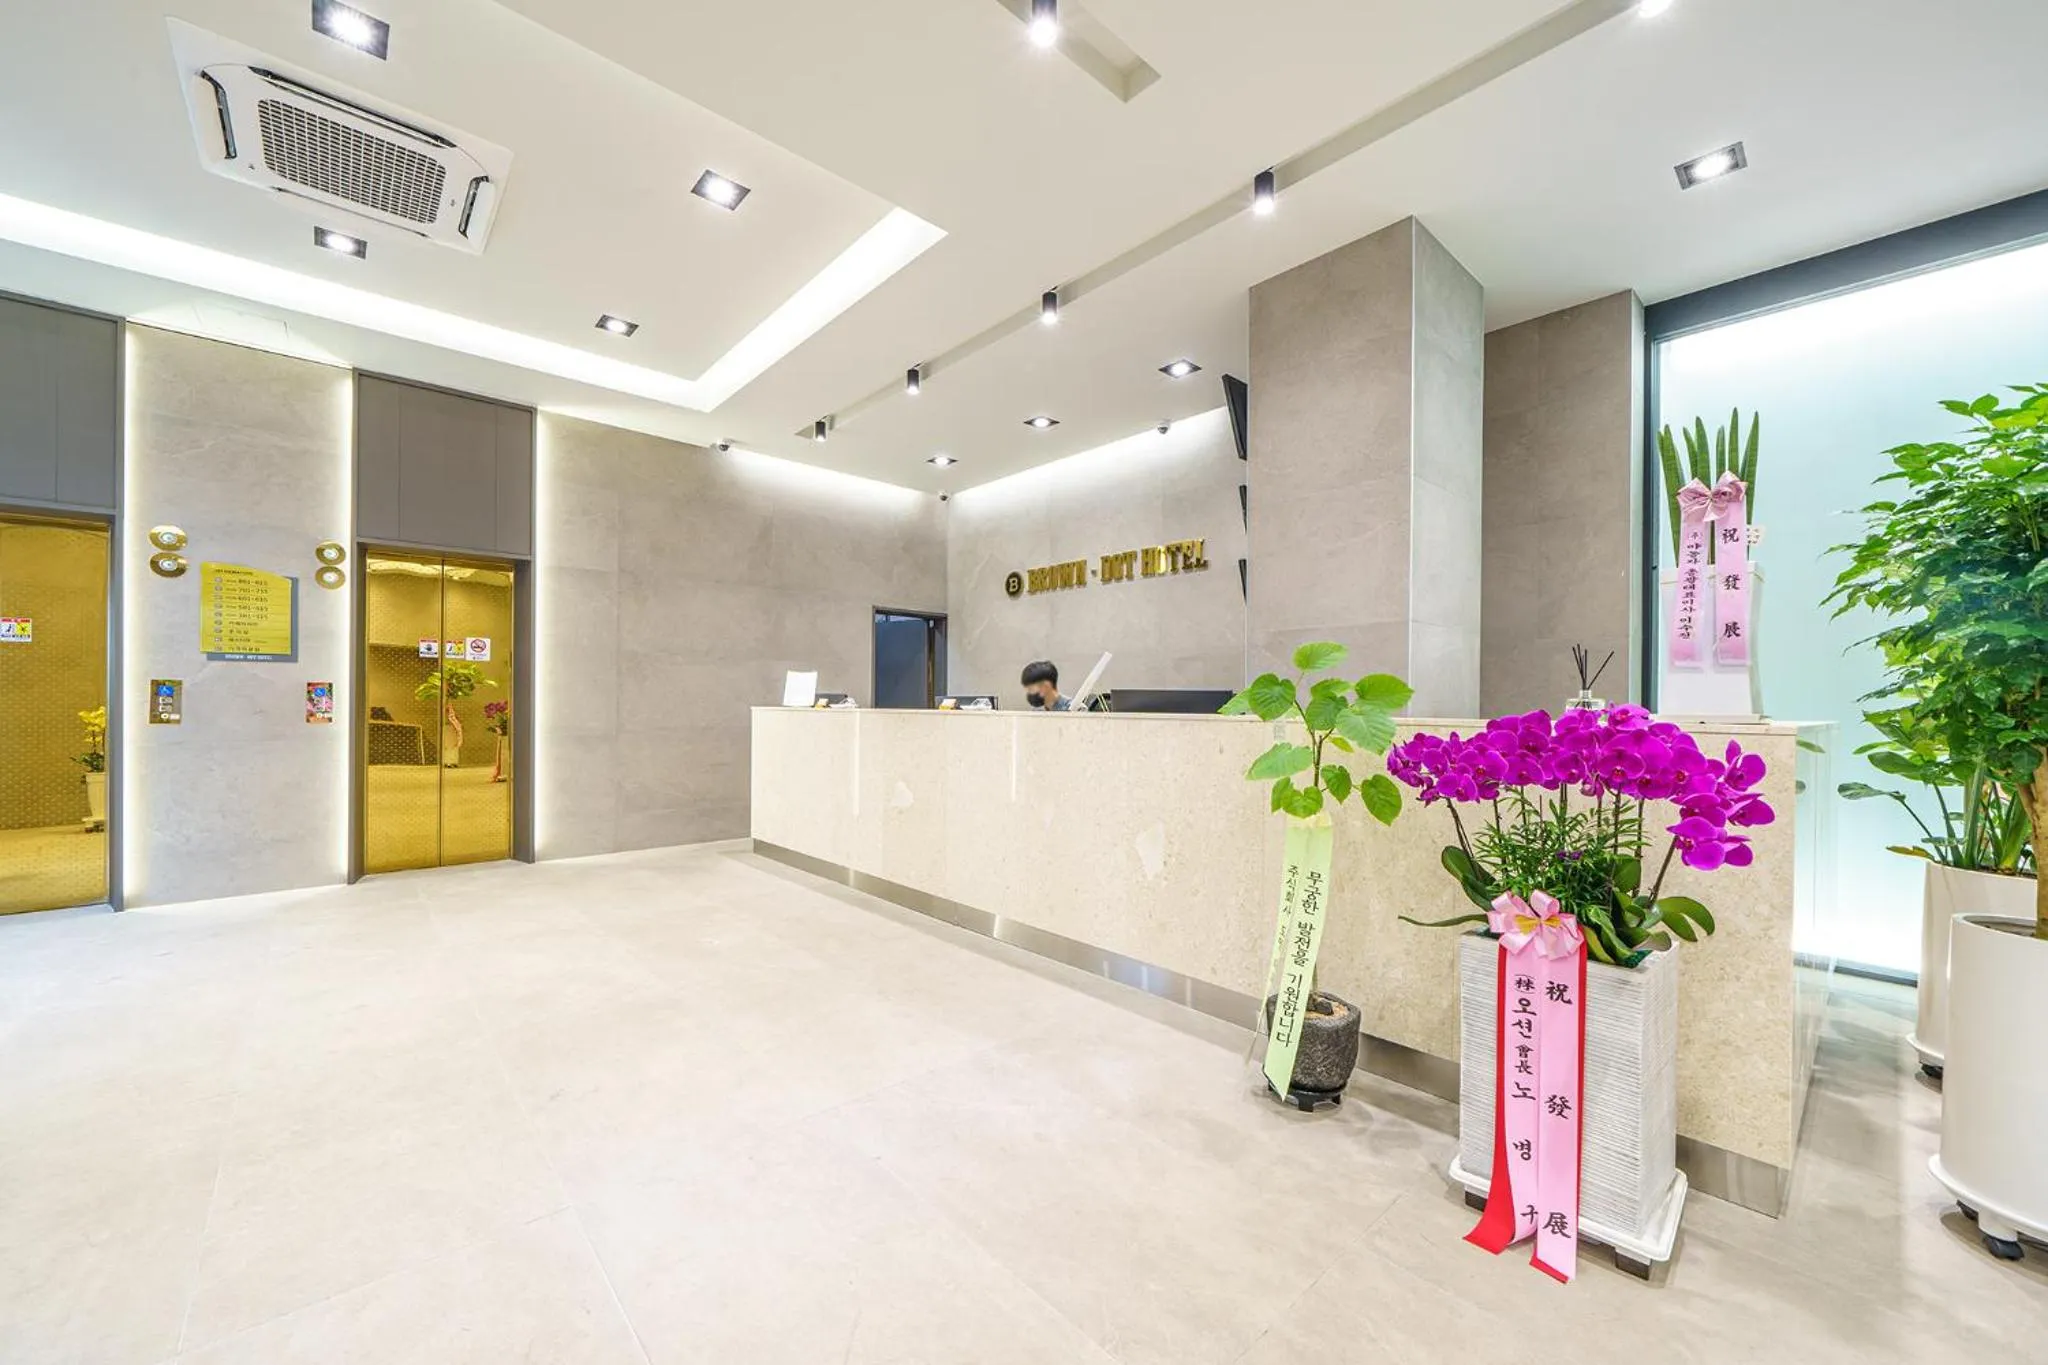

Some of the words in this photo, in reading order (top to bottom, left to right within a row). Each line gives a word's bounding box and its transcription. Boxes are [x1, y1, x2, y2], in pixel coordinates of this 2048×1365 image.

[1140, 536, 1208, 578] HOTEL
[1301, 870, 1323, 916] 무궁한
[1290, 921, 1314, 967] 발전을
[1275, 972, 1303, 1048] 기원합니다
